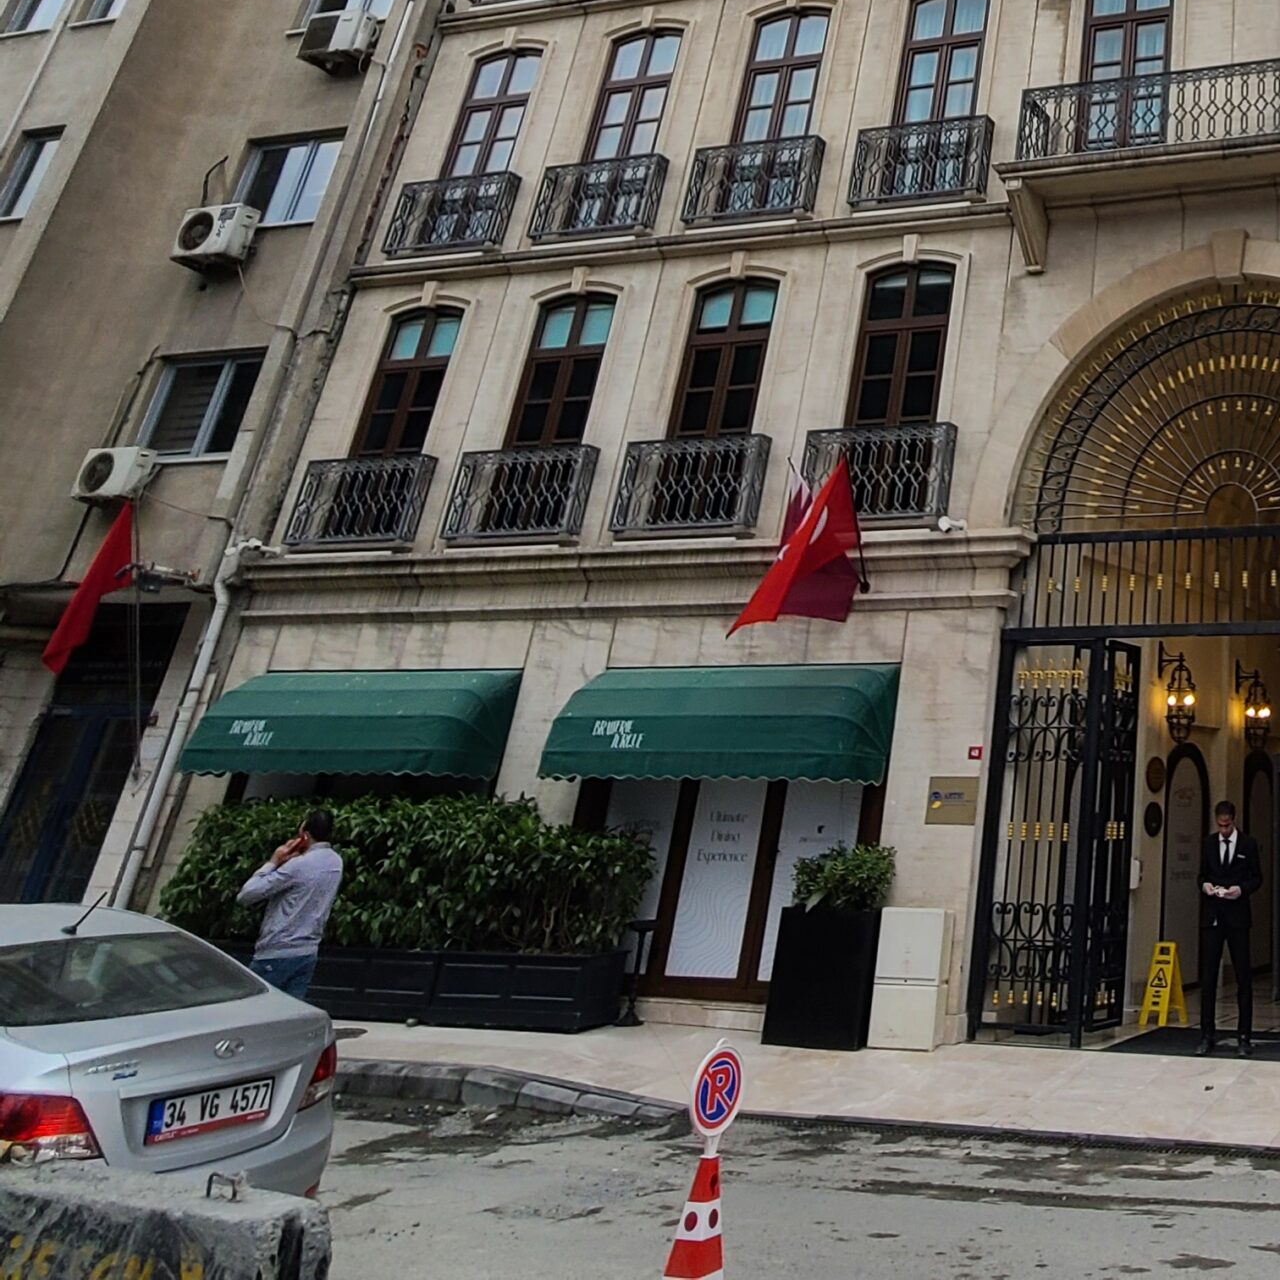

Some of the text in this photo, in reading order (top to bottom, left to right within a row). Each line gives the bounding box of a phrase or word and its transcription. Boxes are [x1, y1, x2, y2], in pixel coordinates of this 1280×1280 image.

[164, 1099, 187, 1128] 34
[200, 1092, 221, 1121] VG
[229, 1082, 271, 1114] 4577
